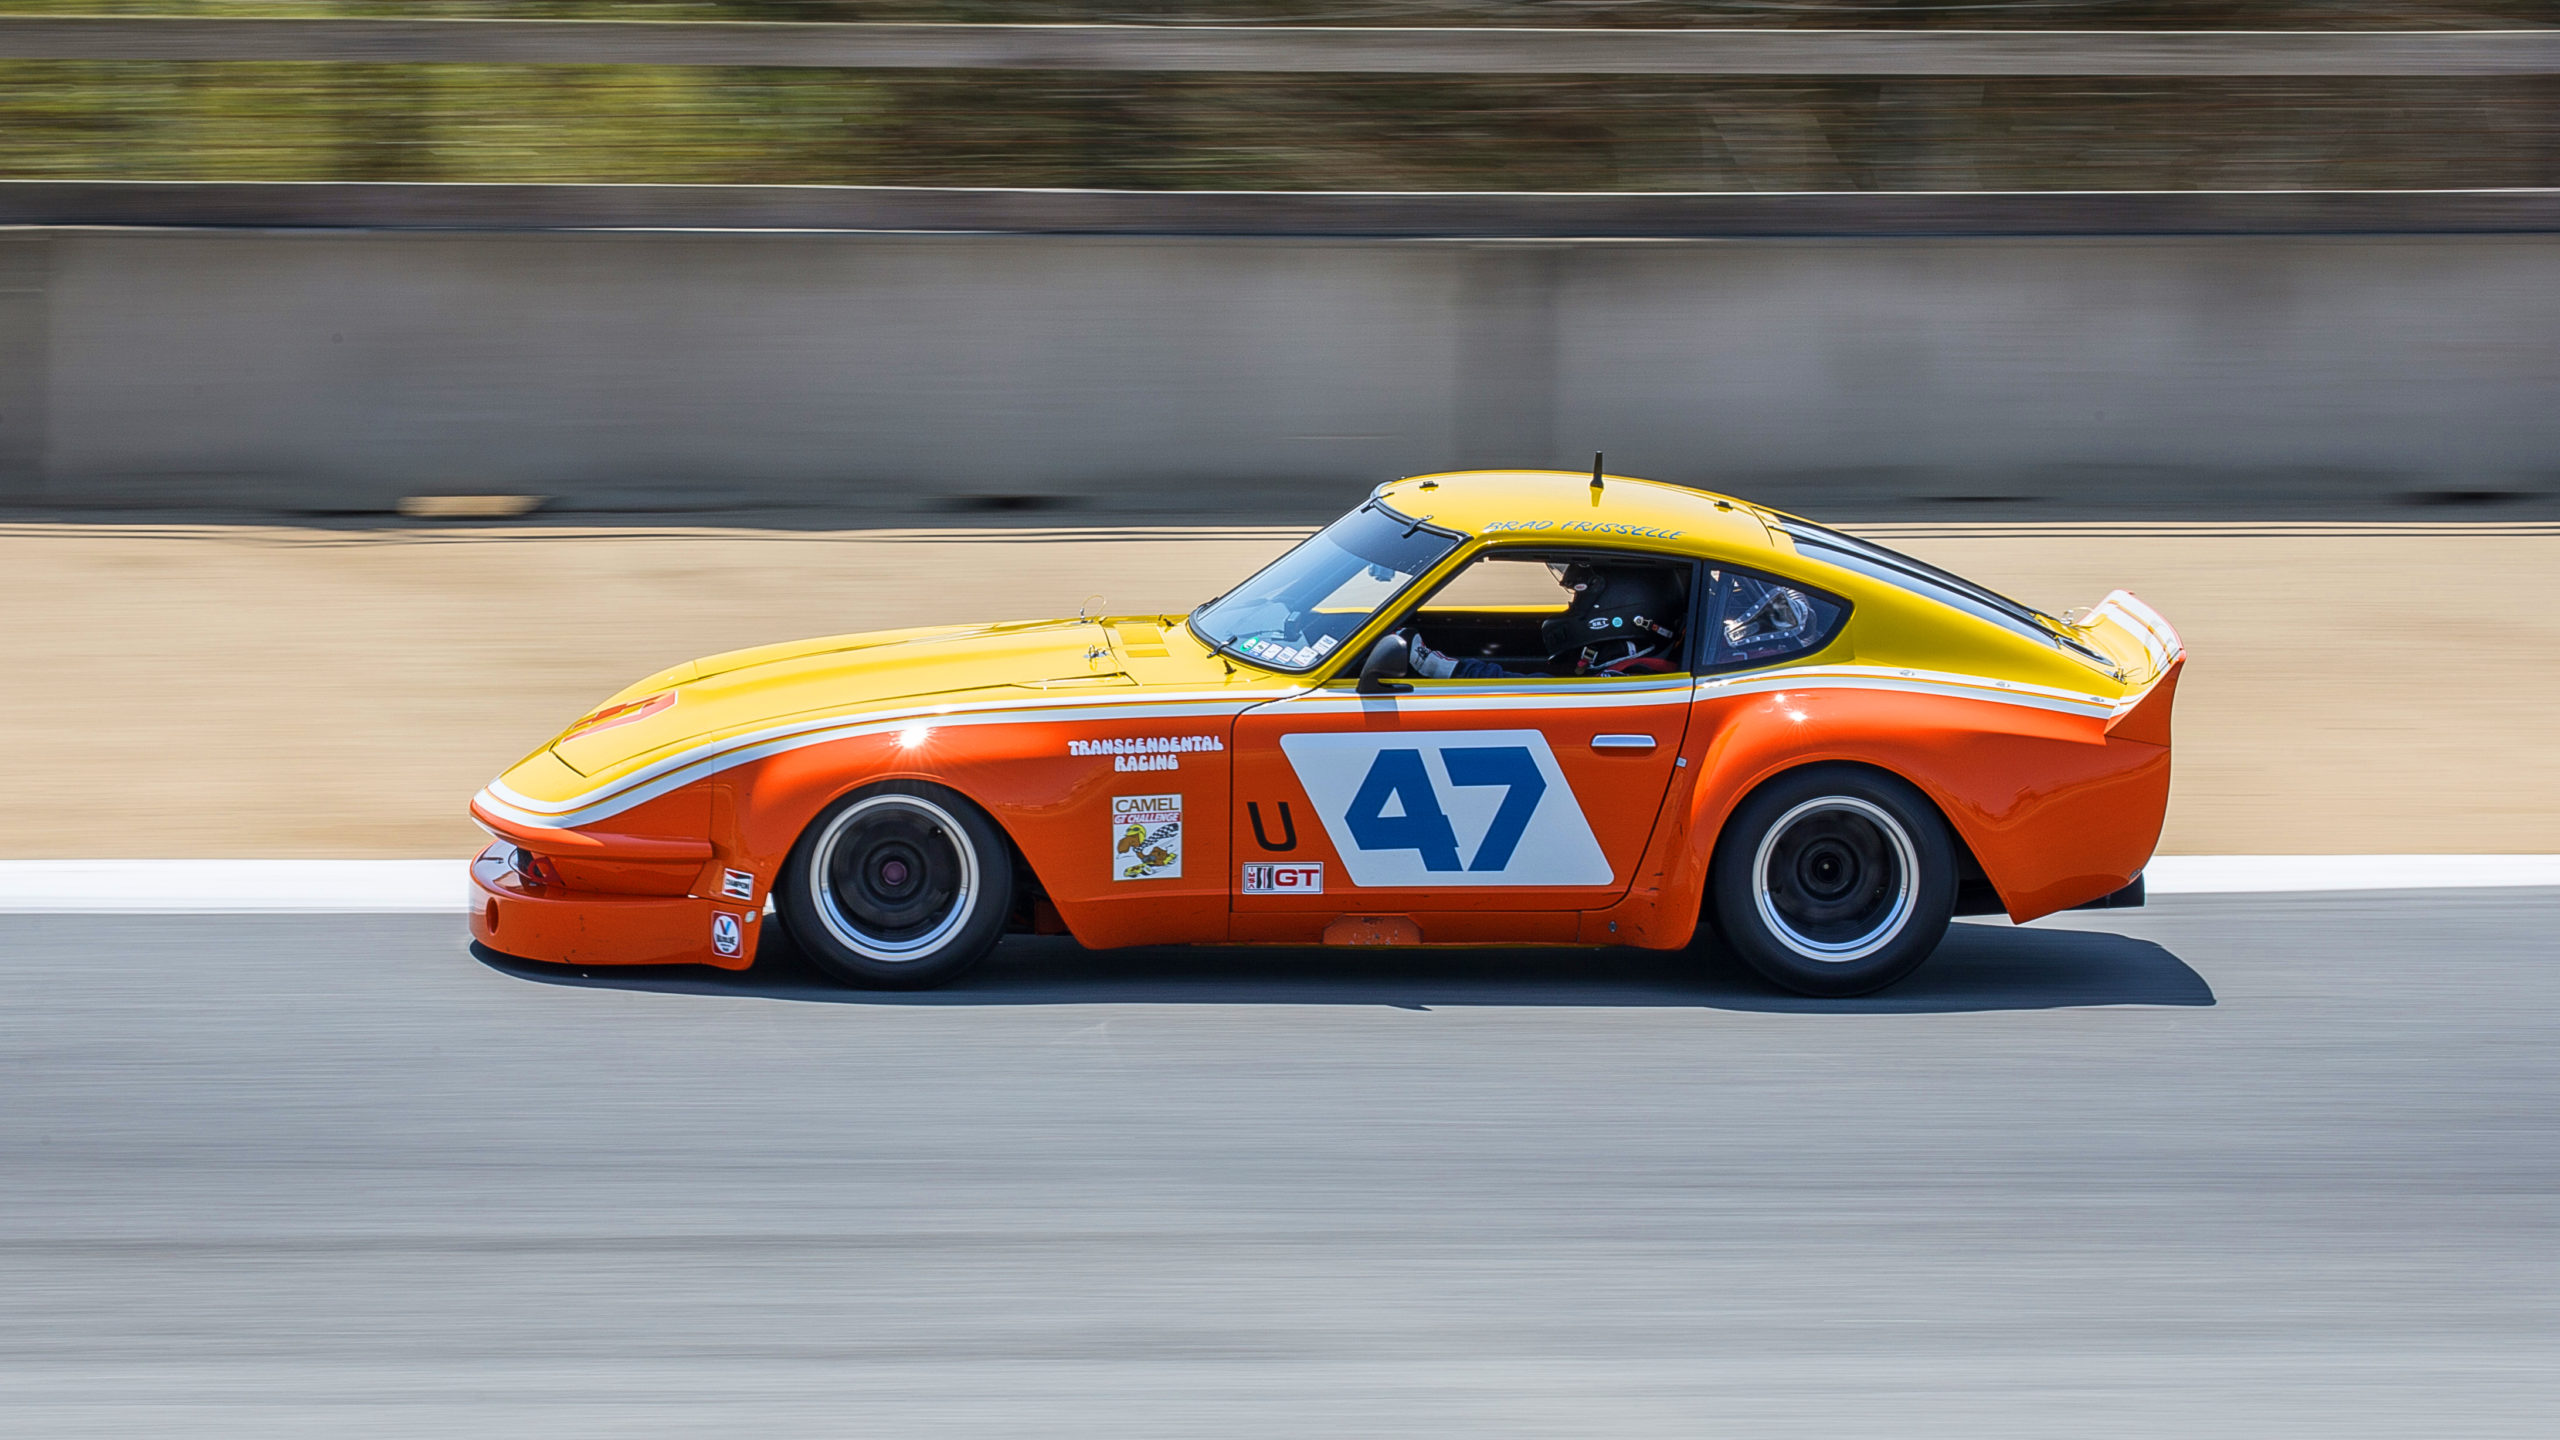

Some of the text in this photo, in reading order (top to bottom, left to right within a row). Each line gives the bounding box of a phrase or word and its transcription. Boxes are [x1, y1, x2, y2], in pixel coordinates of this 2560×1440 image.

[1482, 520, 1687, 540] BRAD FRISSELLE
[1067, 735, 1224, 756] TRANSCENDENTAL
[1114, 754, 1179, 772] RACING
[1115, 797, 1179, 812] CAMEL
[1344, 746, 1547, 872] 47
[1114, 812, 1180, 824] GT CHALLENGE
[1247, 801, 1297, 851] U
[1275, 869, 1319, 886] GT
